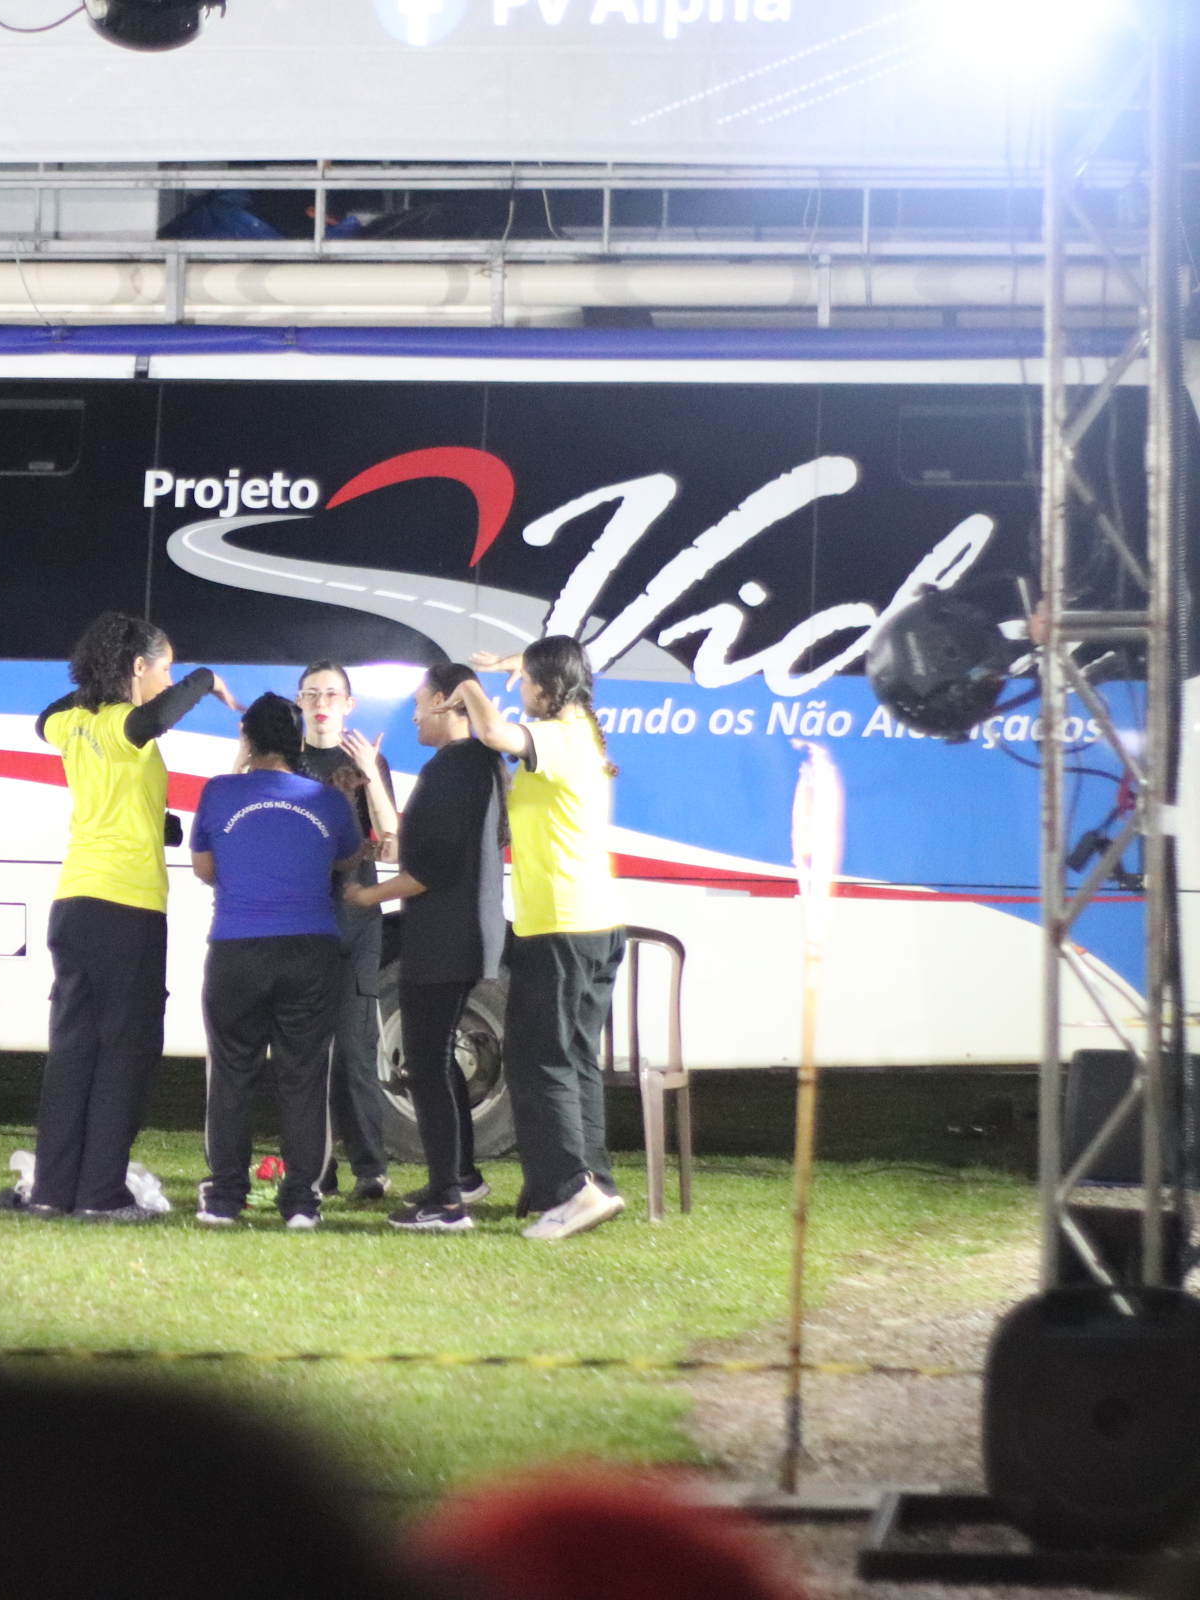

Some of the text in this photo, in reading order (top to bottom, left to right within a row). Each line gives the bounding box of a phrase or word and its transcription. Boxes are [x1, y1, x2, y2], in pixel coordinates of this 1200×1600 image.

[143, 468, 319, 518] Projeto
[708, 709, 754, 735] os
[765, 700, 851, 738] Não
[223, 800, 330, 839] ALCANÇANDO OS NÃO ALCANÇADOS
